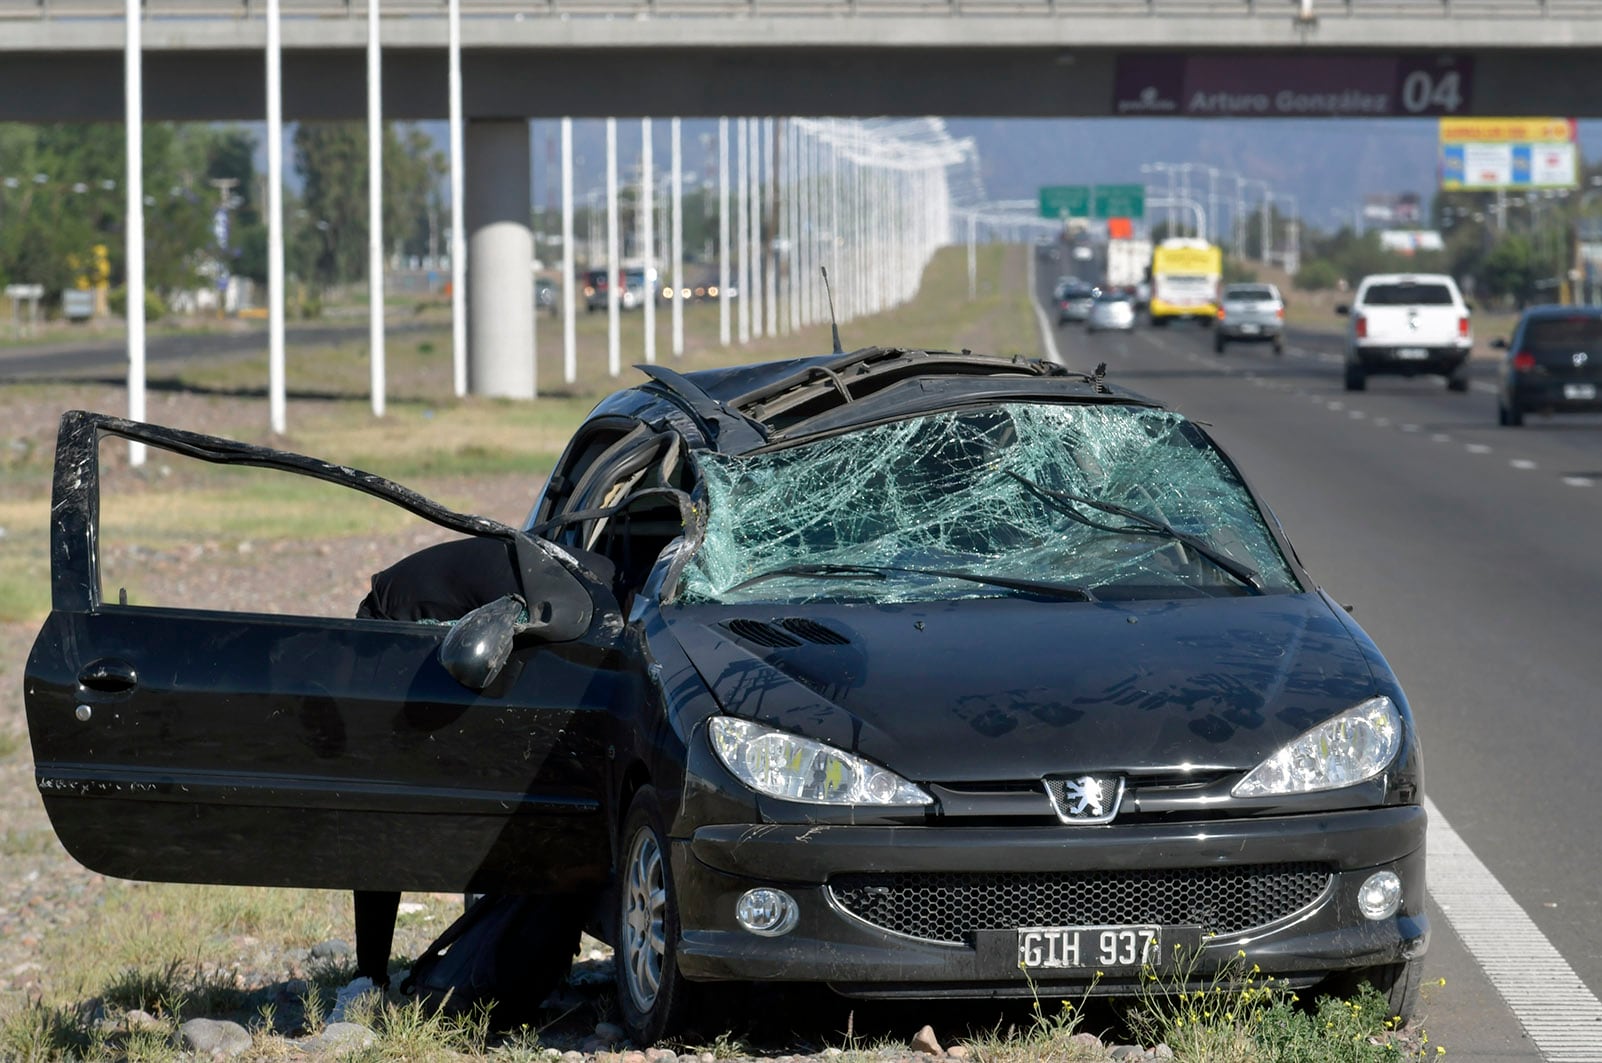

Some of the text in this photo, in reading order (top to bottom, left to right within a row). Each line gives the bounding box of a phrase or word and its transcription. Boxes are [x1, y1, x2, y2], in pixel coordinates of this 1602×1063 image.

[1189, 91, 1269, 112] Arturo
[1275, 89, 1388, 112] González
[1402, 70, 1462, 113] 04
[1024, 930, 1155, 966] GIH 937
